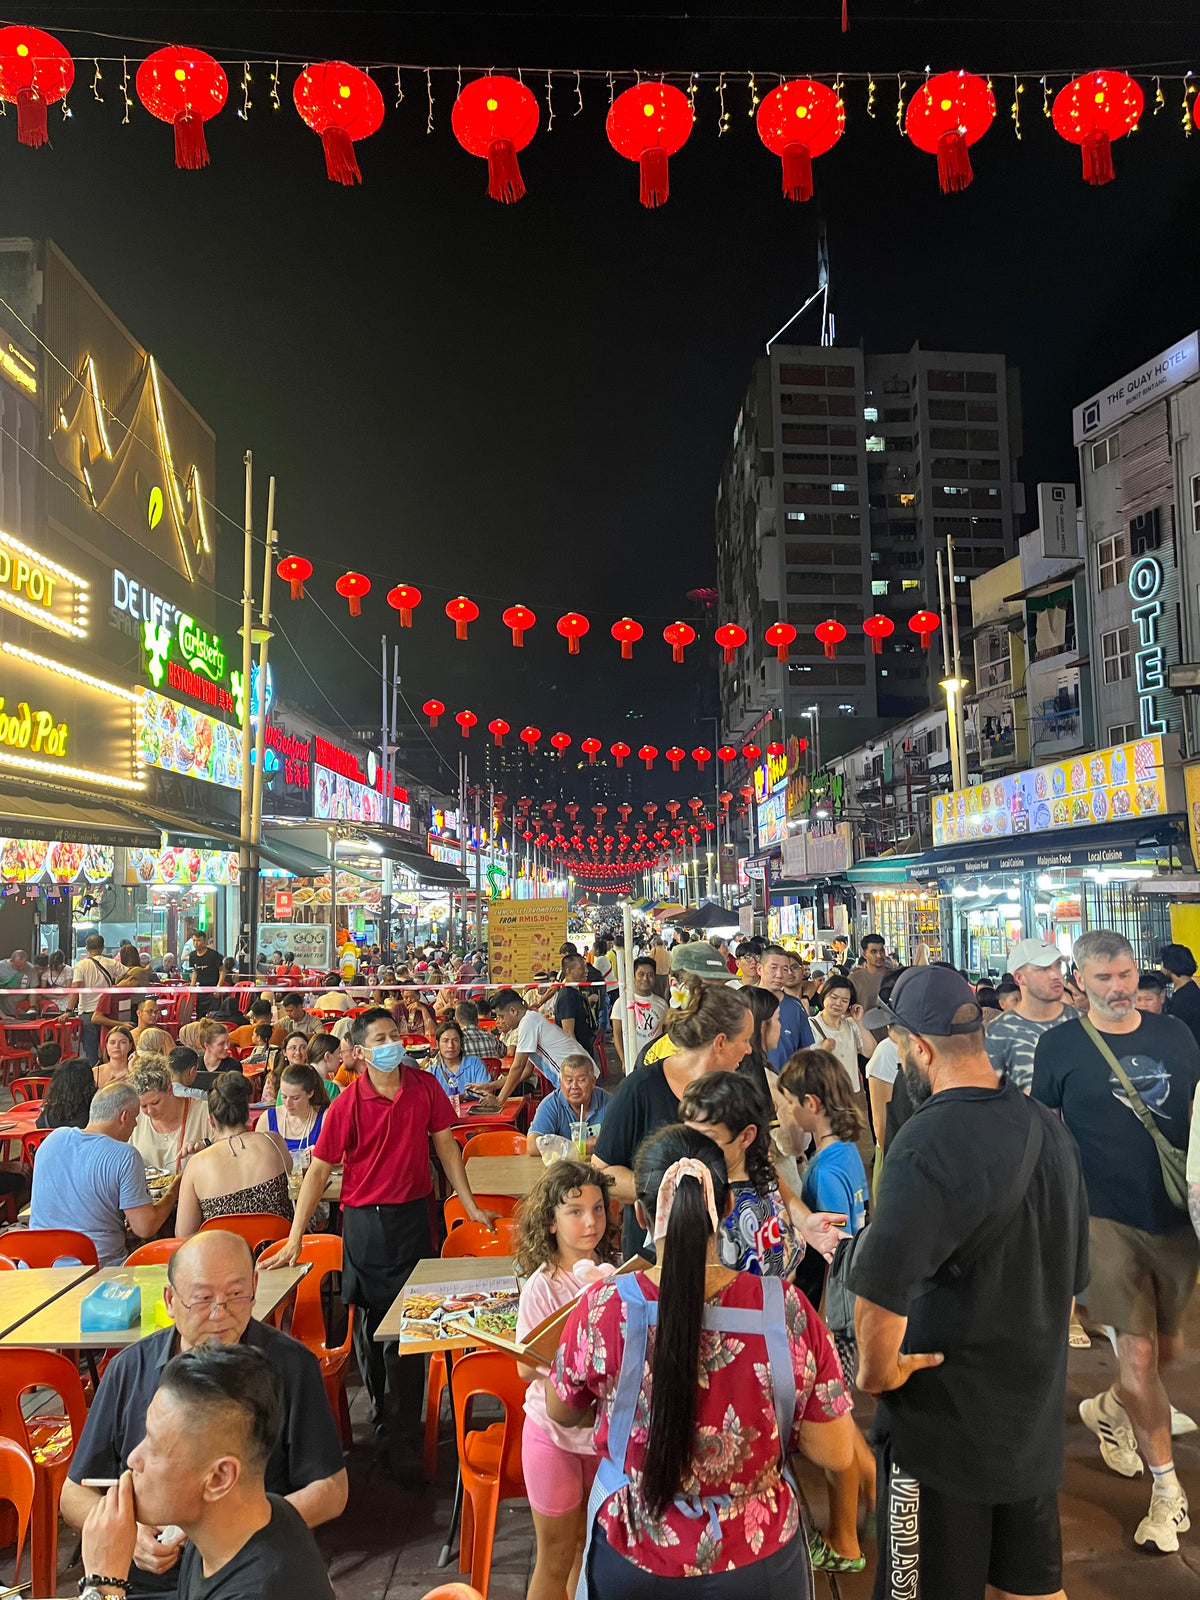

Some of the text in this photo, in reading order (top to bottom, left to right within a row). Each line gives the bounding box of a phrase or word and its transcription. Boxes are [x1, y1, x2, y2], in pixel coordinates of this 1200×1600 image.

[1106, 349, 1188, 406] THE QUAY HOTEL
[1125, 376, 1167, 406] BUKIT BINTANG
[12, 559, 57, 607] POT
[113, 568, 140, 620] DE
[1128, 507, 1167, 738] HOTEL
[178, 613, 225, 679] Carlsberg
[167, 660, 201, 699] RESTORAN
[31, 710, 68, 757] Pot
[721, 847, 735, 857] 4D
[1000, 857, 1025, 869] Local Cuisine
[1037, 853, 1072, 867] Malaysian Food
[1087, 849, 1123, 862] Local Cuisine
[494, 908, 514, 916] LUNCH
[527, 906, 563, 914] PROMOTION
[499, 915, 558, 924] FROM RM15.90++
